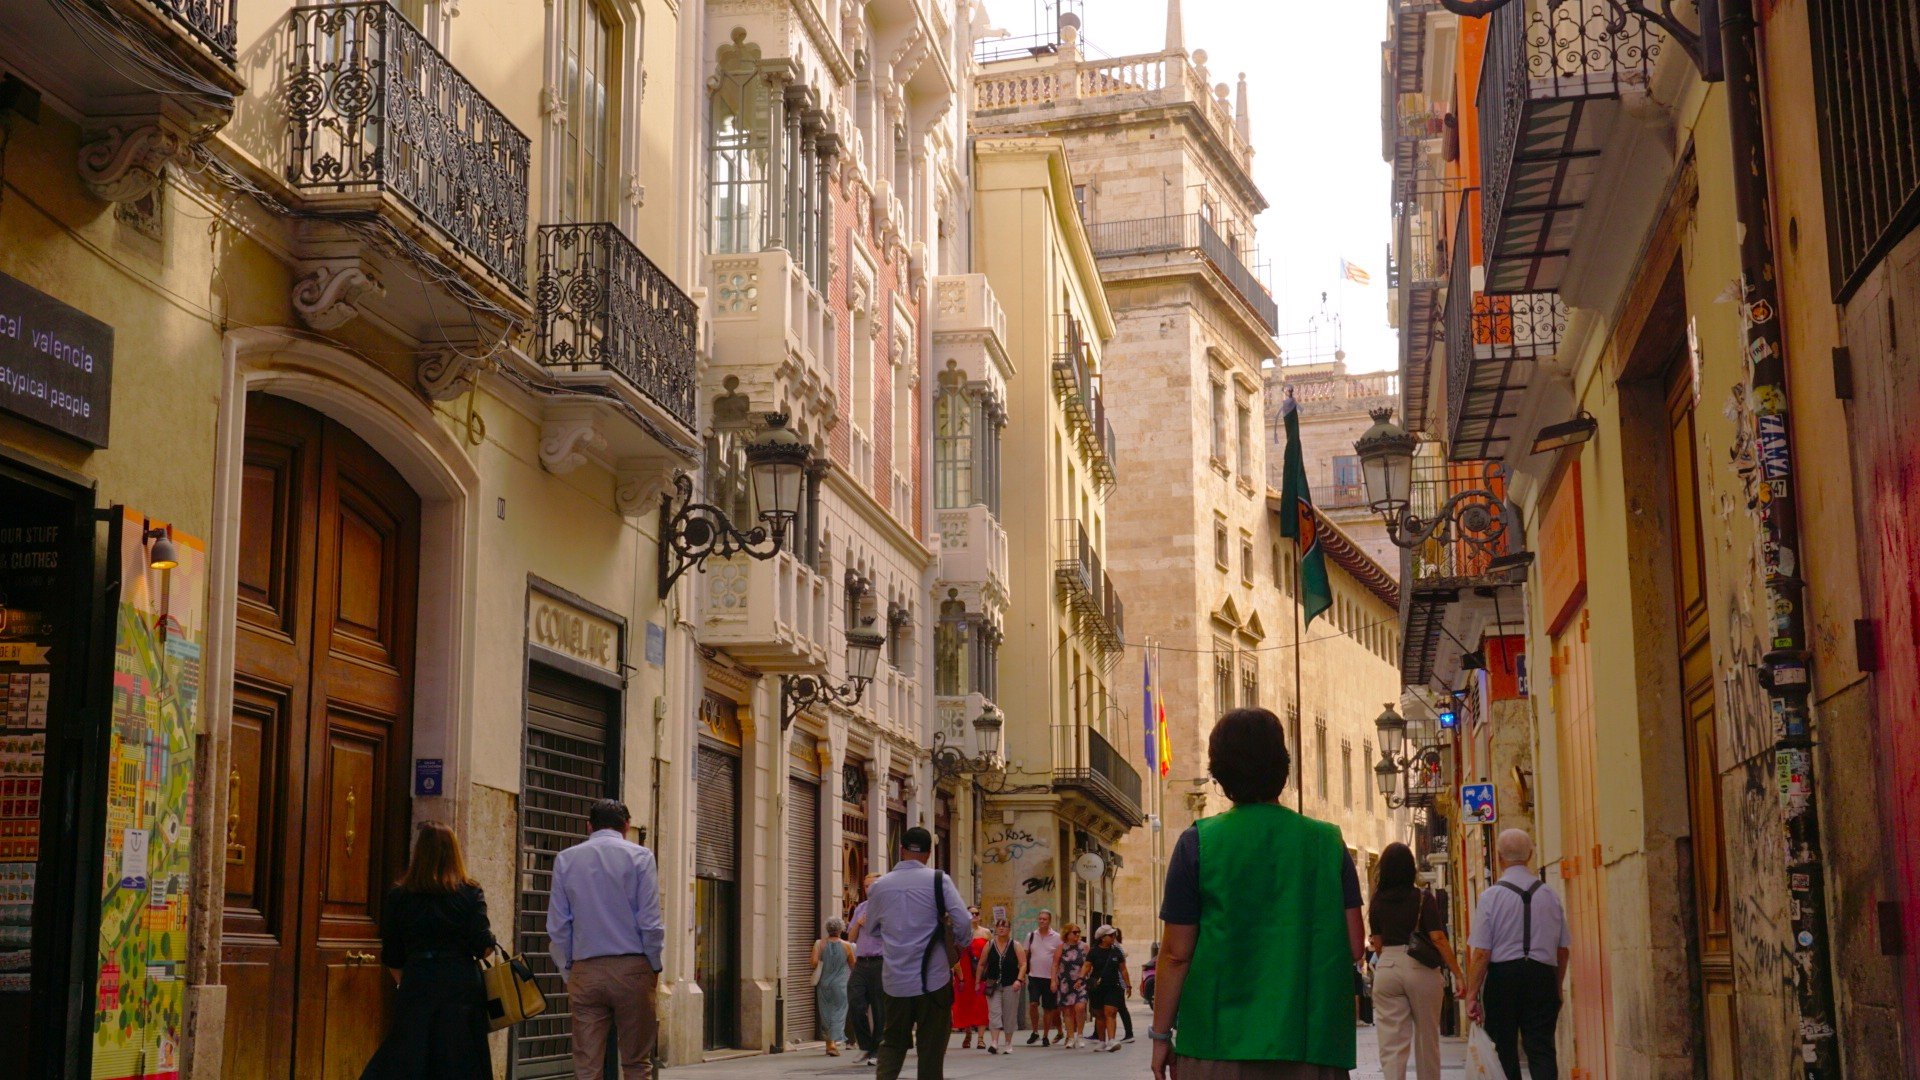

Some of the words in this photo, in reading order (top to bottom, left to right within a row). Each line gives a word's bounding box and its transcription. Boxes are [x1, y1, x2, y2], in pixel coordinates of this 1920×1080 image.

[32, 329, 94, 373] valencia
[0, 365, 48, 400] atypical
[50, 388, 90, 418] people
[1760, 415, 1789, 478] ZAMZ
[26, 526, 59, 544] STUFF
[10, 551, 59, 569] CLOTHES
